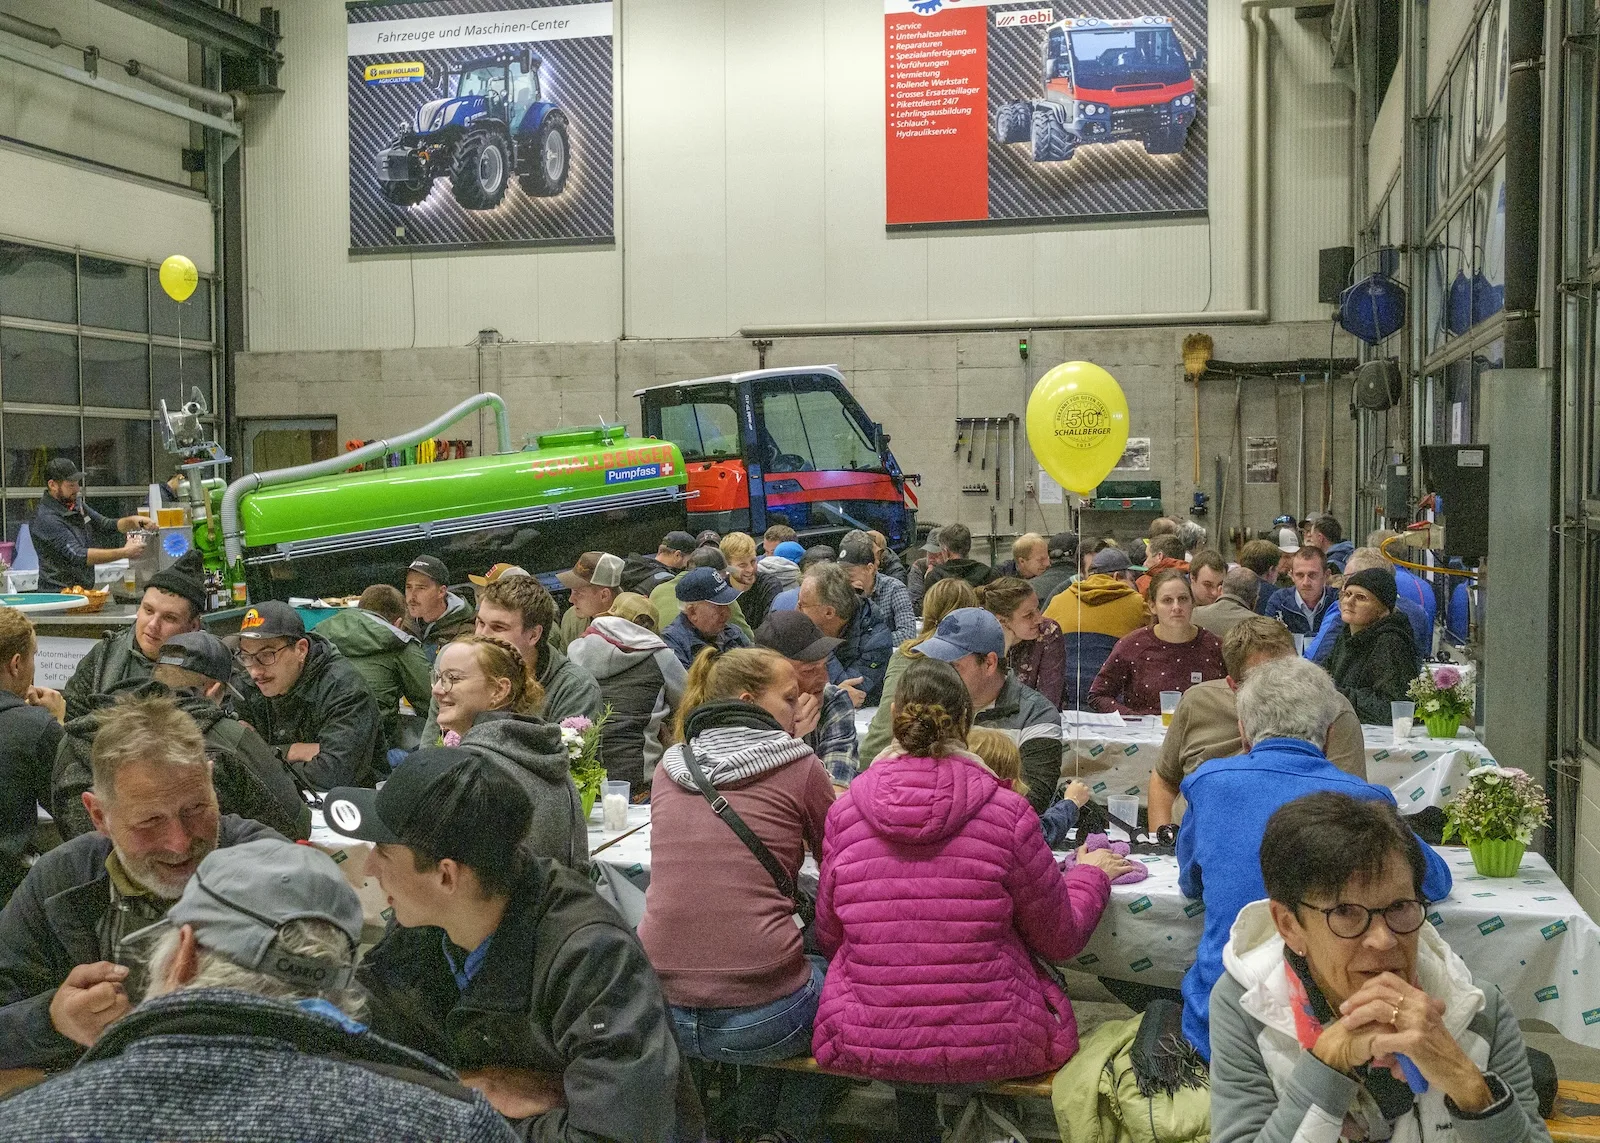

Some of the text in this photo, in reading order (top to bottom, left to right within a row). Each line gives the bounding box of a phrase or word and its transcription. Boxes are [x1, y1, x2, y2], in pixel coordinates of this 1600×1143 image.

[1019, 12, 1051, 24] aebi
[376, 18, 571, 44] Fahrzeuge und Maschinen-Center
[895, 22, 922, 31] Service
[895, 29, 967, 41] Unterhaltsarbeiten
[895, 40, 943, 51] Reparaturen
[895, 48, 977, 61] Spezialanfertigungen
[896, 60, 949, 70] Vorführungen
[378, 66, 420, 76] NEW HOLLAND
[896, 70, 941, 80] Vermietung
[378, 76, 411, 84] AGRICULTURE
[896, 78, 969, 89] Rollende Werkstatt
[896, 87, 980, 99] Grosses Ersatzteillager
[896, 98, 959, 109] Pikettdienst 24/7
[896, 107, 972, 119] Lehrlingsausbildung
[896, 119, 929, 129] Schlauch
[896, 128, 957, 139] Hydraulikservice
[1066, 409, 1098, 428] 50
[1054, 428, 1111, 436] SCHALLBERGER
[532, 445, 675, 480] SCHALLBERGER
[608, 467, 657, 481] Pumpfass
[54, 662, 76, 670] Check
